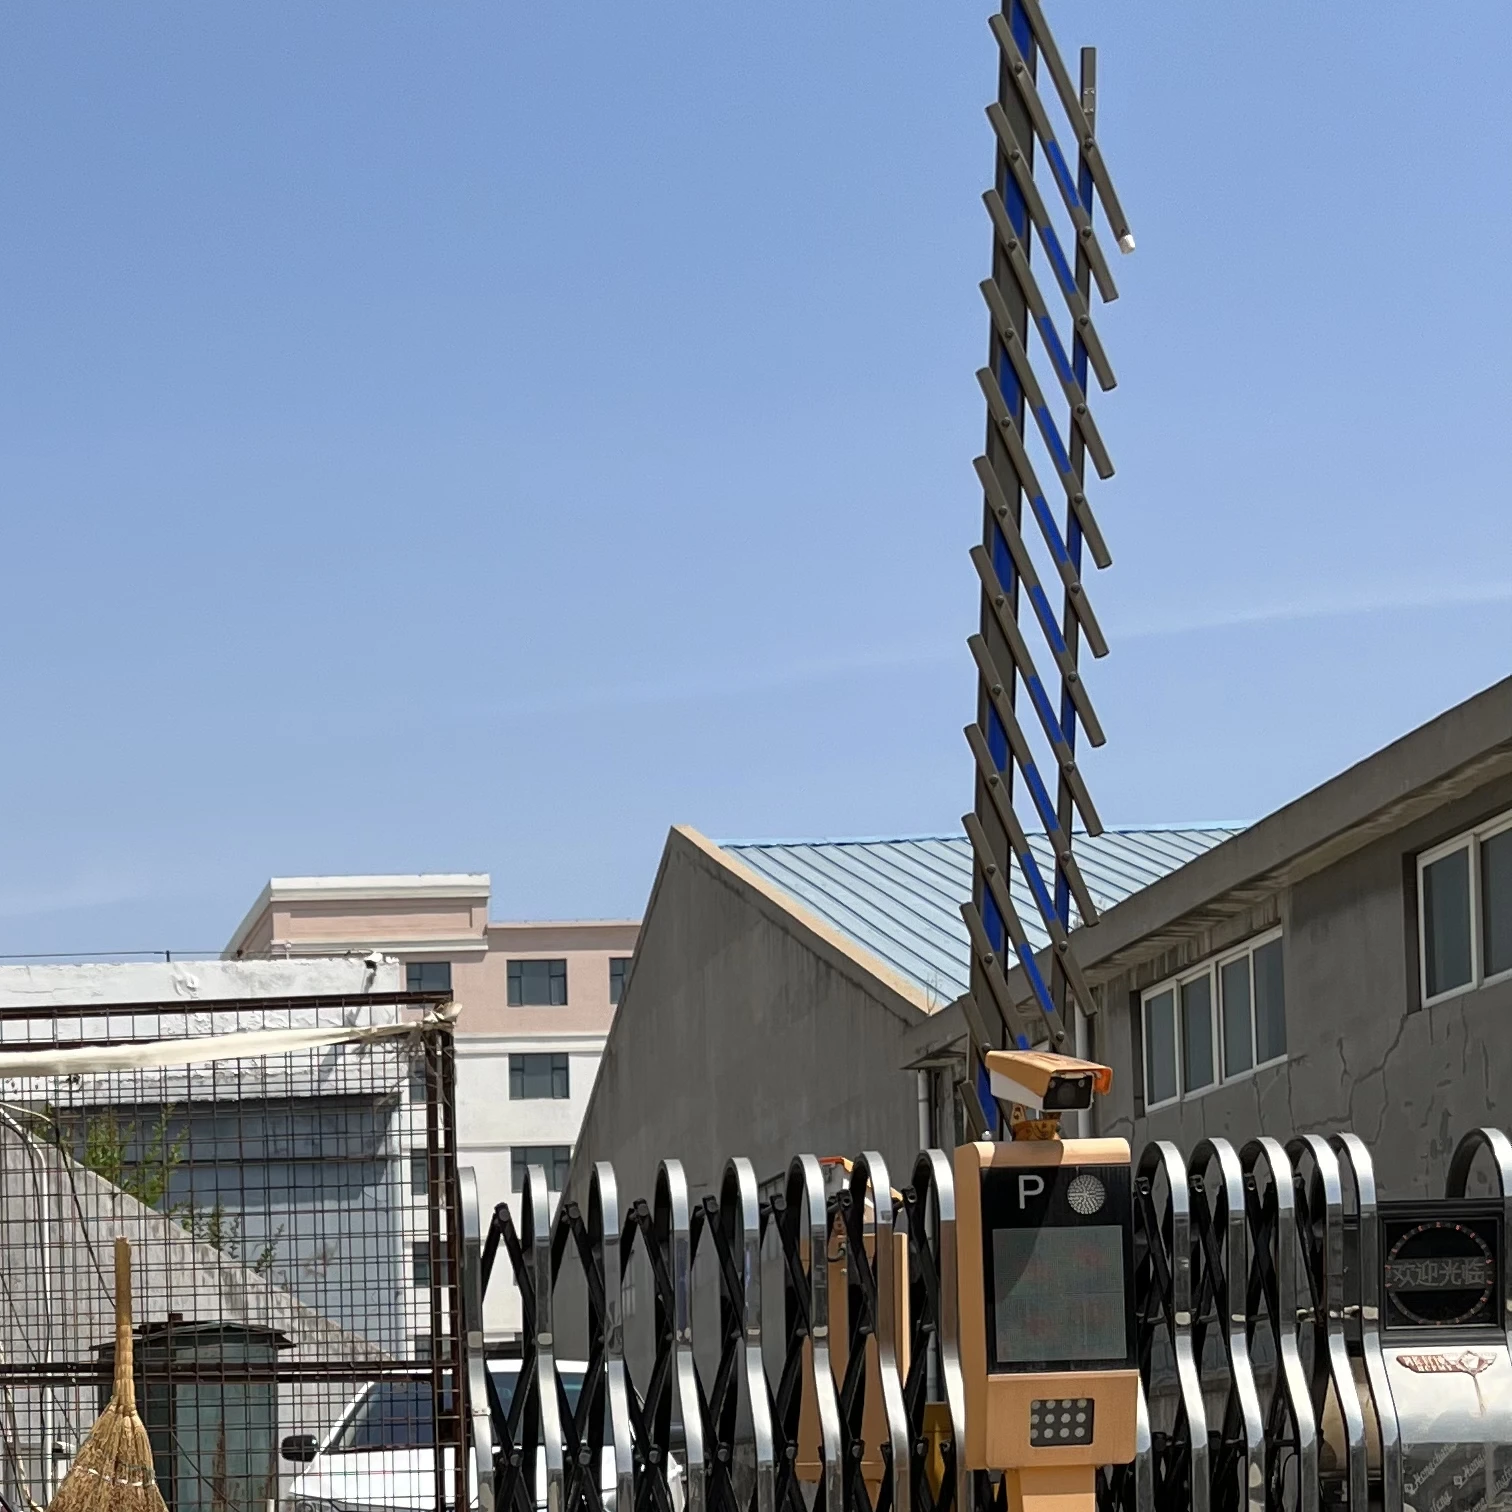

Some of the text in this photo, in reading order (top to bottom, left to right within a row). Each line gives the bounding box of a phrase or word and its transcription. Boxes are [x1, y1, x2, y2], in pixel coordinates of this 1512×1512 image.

[1018, 1174, 1045, 1210] P
[1391, 1257, 1485, 1288] 欢迎光临
